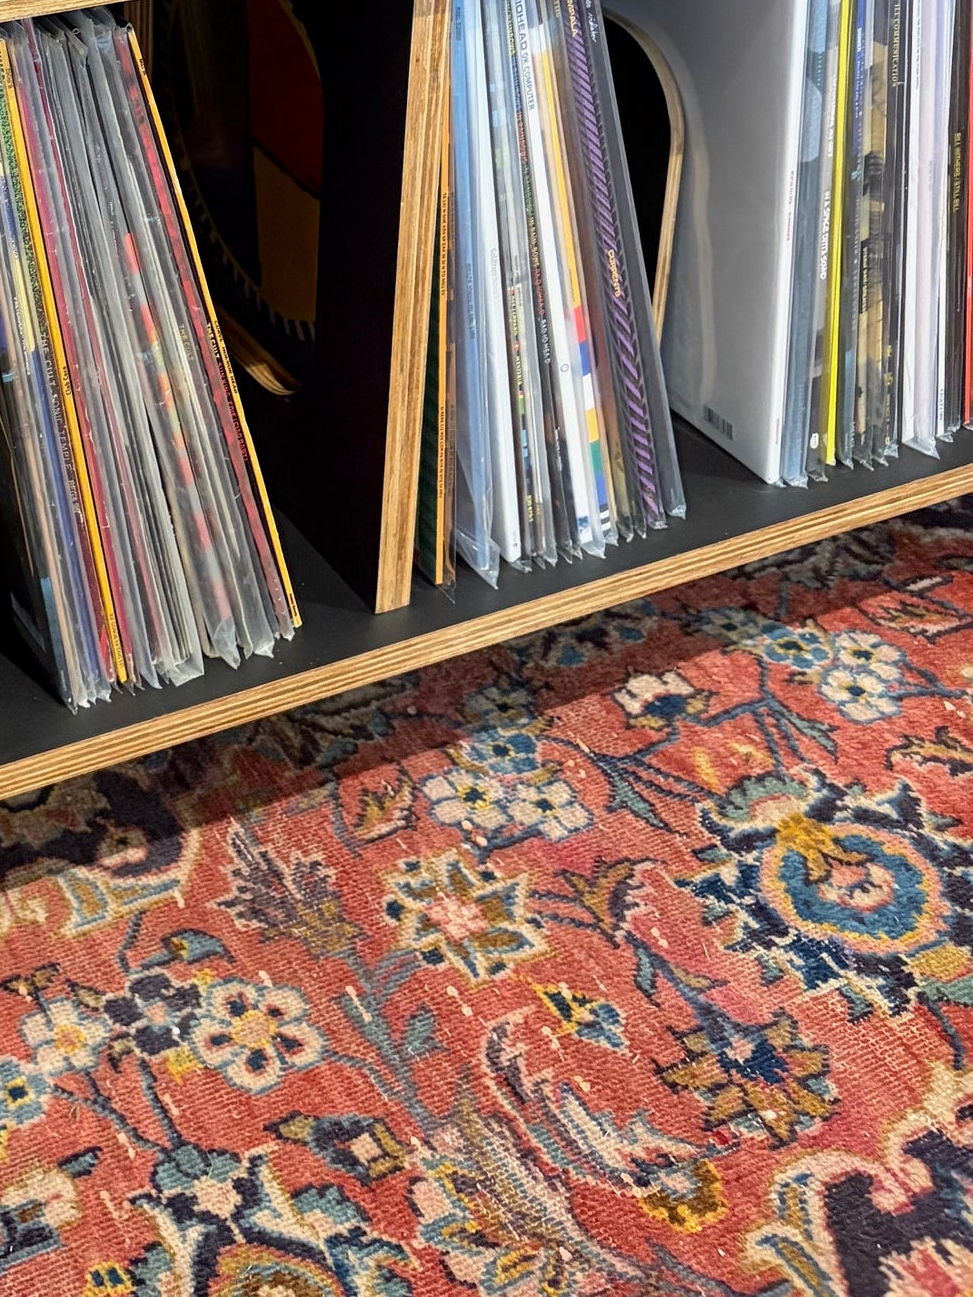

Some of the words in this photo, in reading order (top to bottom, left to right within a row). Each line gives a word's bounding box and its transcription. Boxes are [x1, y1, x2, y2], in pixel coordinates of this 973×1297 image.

[520, 51, 530, 64] OK
[891, 18, 900, 87] COMMUNICATION
[522, 65, 535, 110] COMPUTER
[606, 248, 621, 297] CURRENTS
[38, 332, 50, 354] THE
[178, 323, 187, 340] THE
[204, 321, 215, 339] THE
[42, 358, 57, 387] CULT
[228, 374, 239, 394] HEAD
[49, 393, 64, 424] SONIC
[57, 430, 72, 470] TEMPLE
